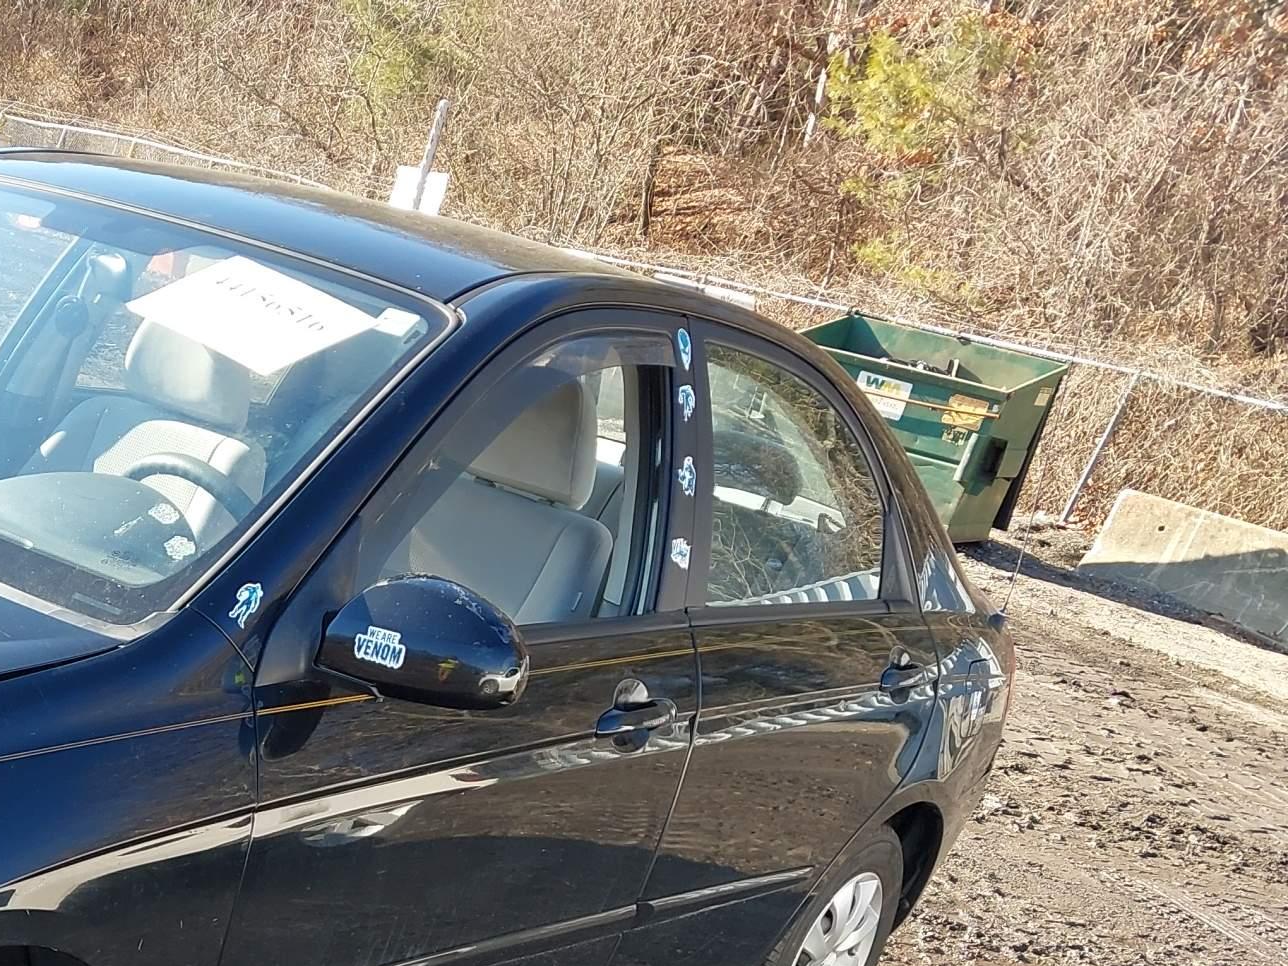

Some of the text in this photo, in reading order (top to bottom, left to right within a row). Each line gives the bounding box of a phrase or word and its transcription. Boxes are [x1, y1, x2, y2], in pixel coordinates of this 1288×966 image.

[368, 628, 399, 644] WE ARE
[356, 635, 403, 665] VENOM
